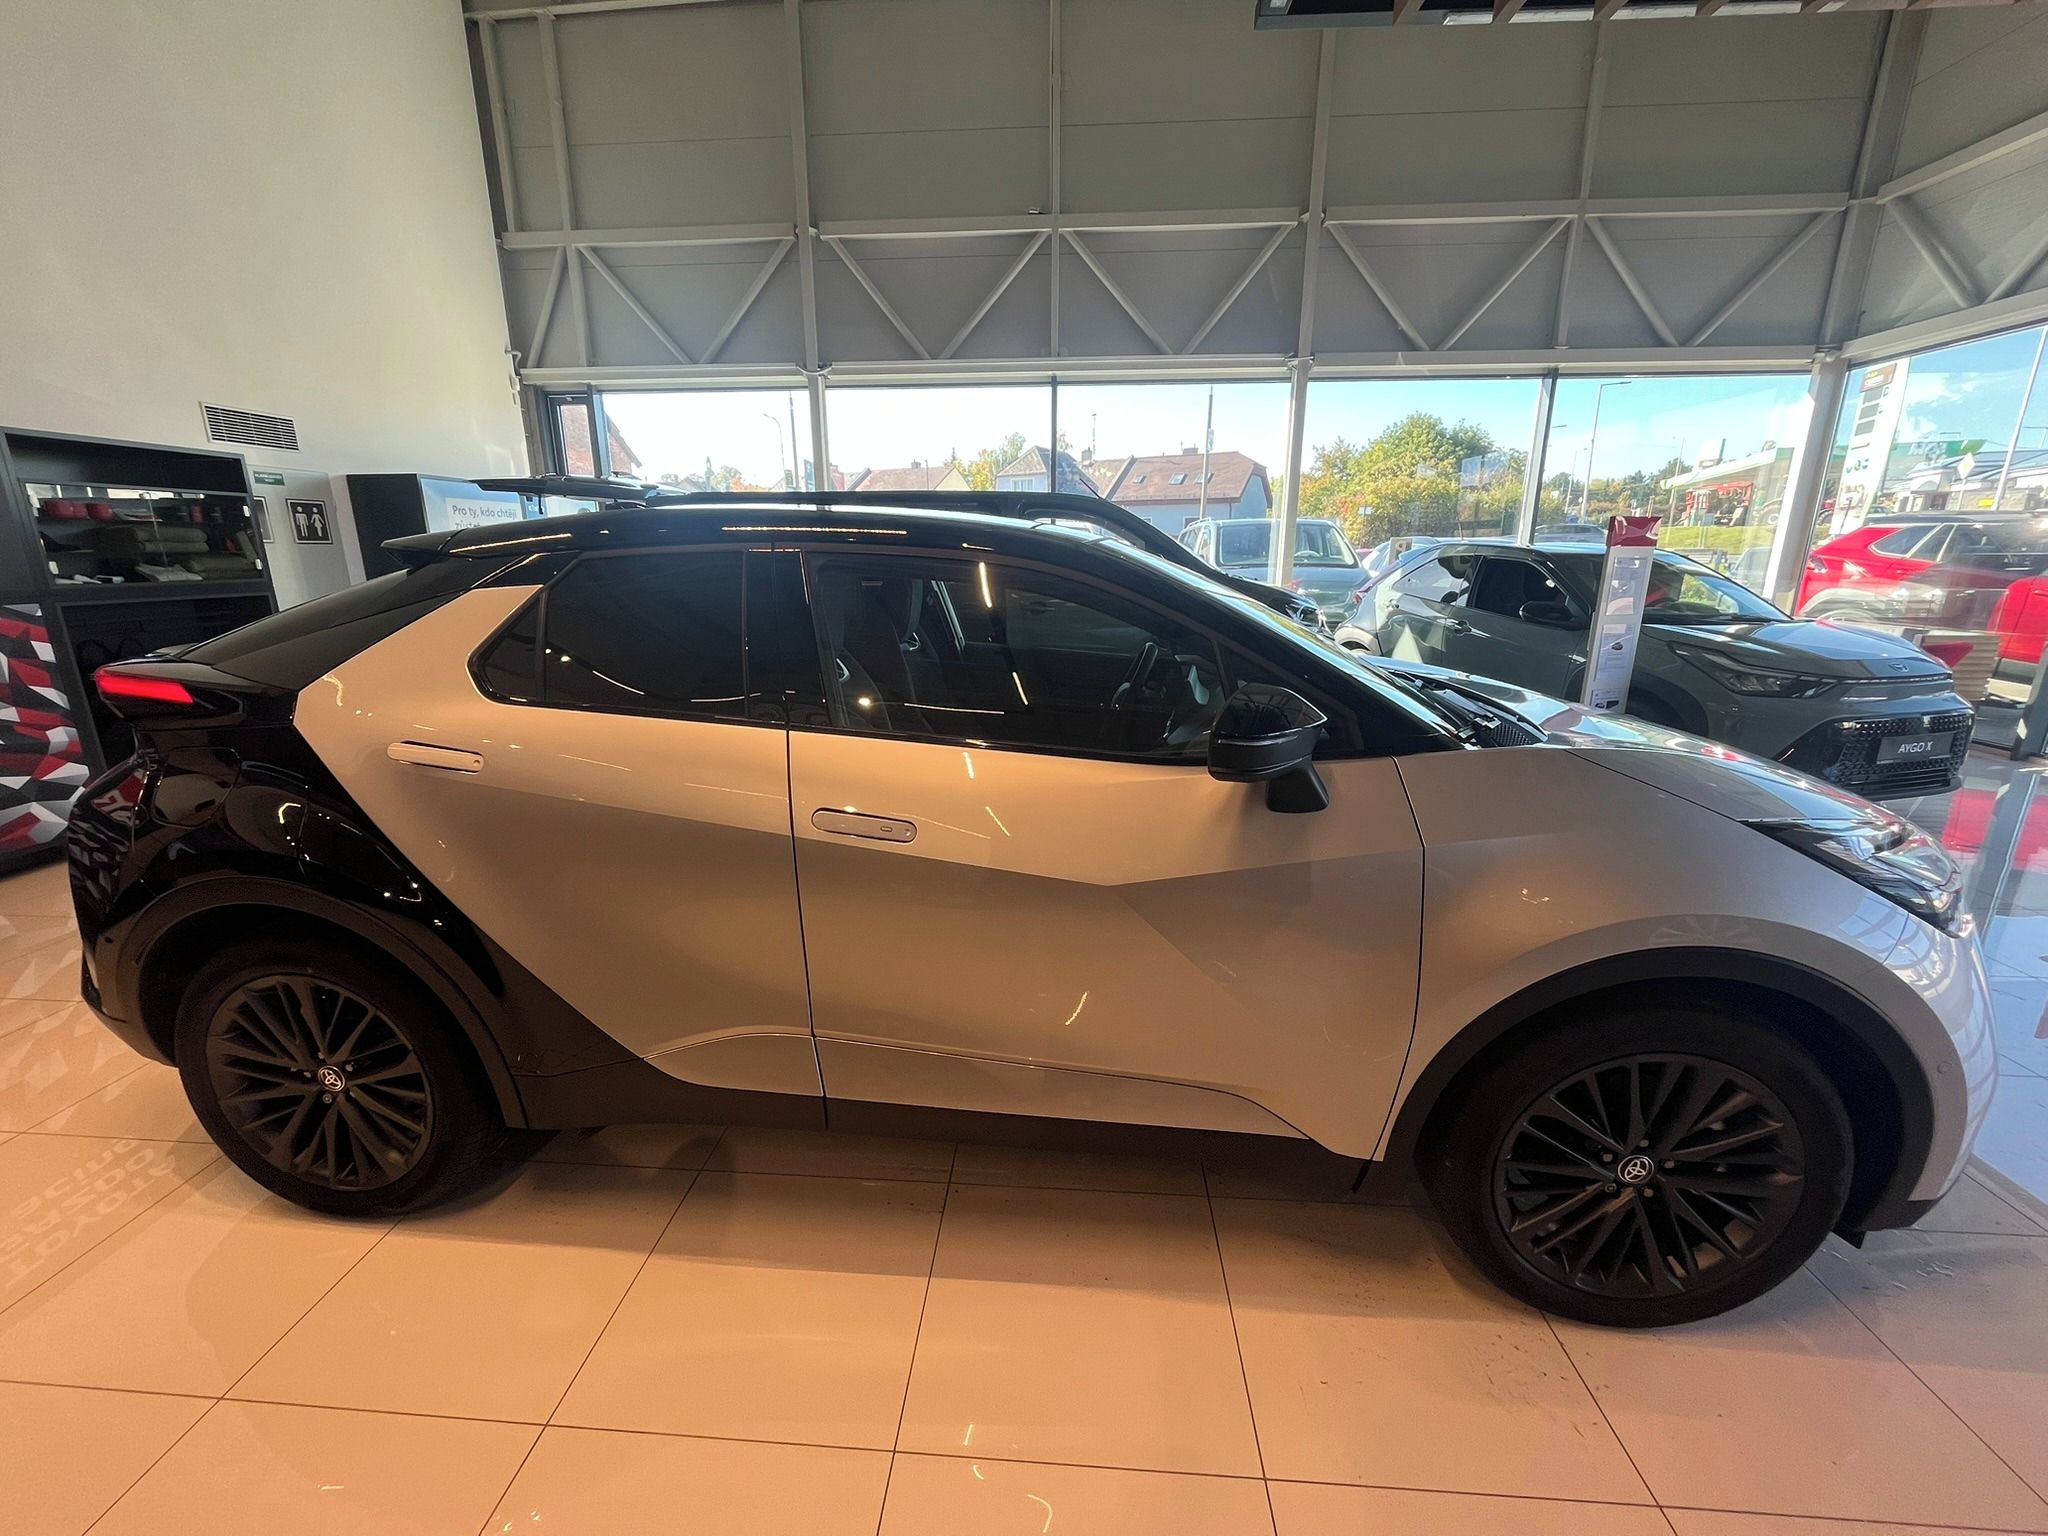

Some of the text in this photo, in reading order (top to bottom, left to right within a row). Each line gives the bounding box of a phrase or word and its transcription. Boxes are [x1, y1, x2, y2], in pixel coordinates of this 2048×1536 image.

[452, 505, 467, 516] Pro
[468, 507, 479, 519] ty,
[480, 506, 495, 517] kdo
[1897, 741, 1933, 753] AYGO X
